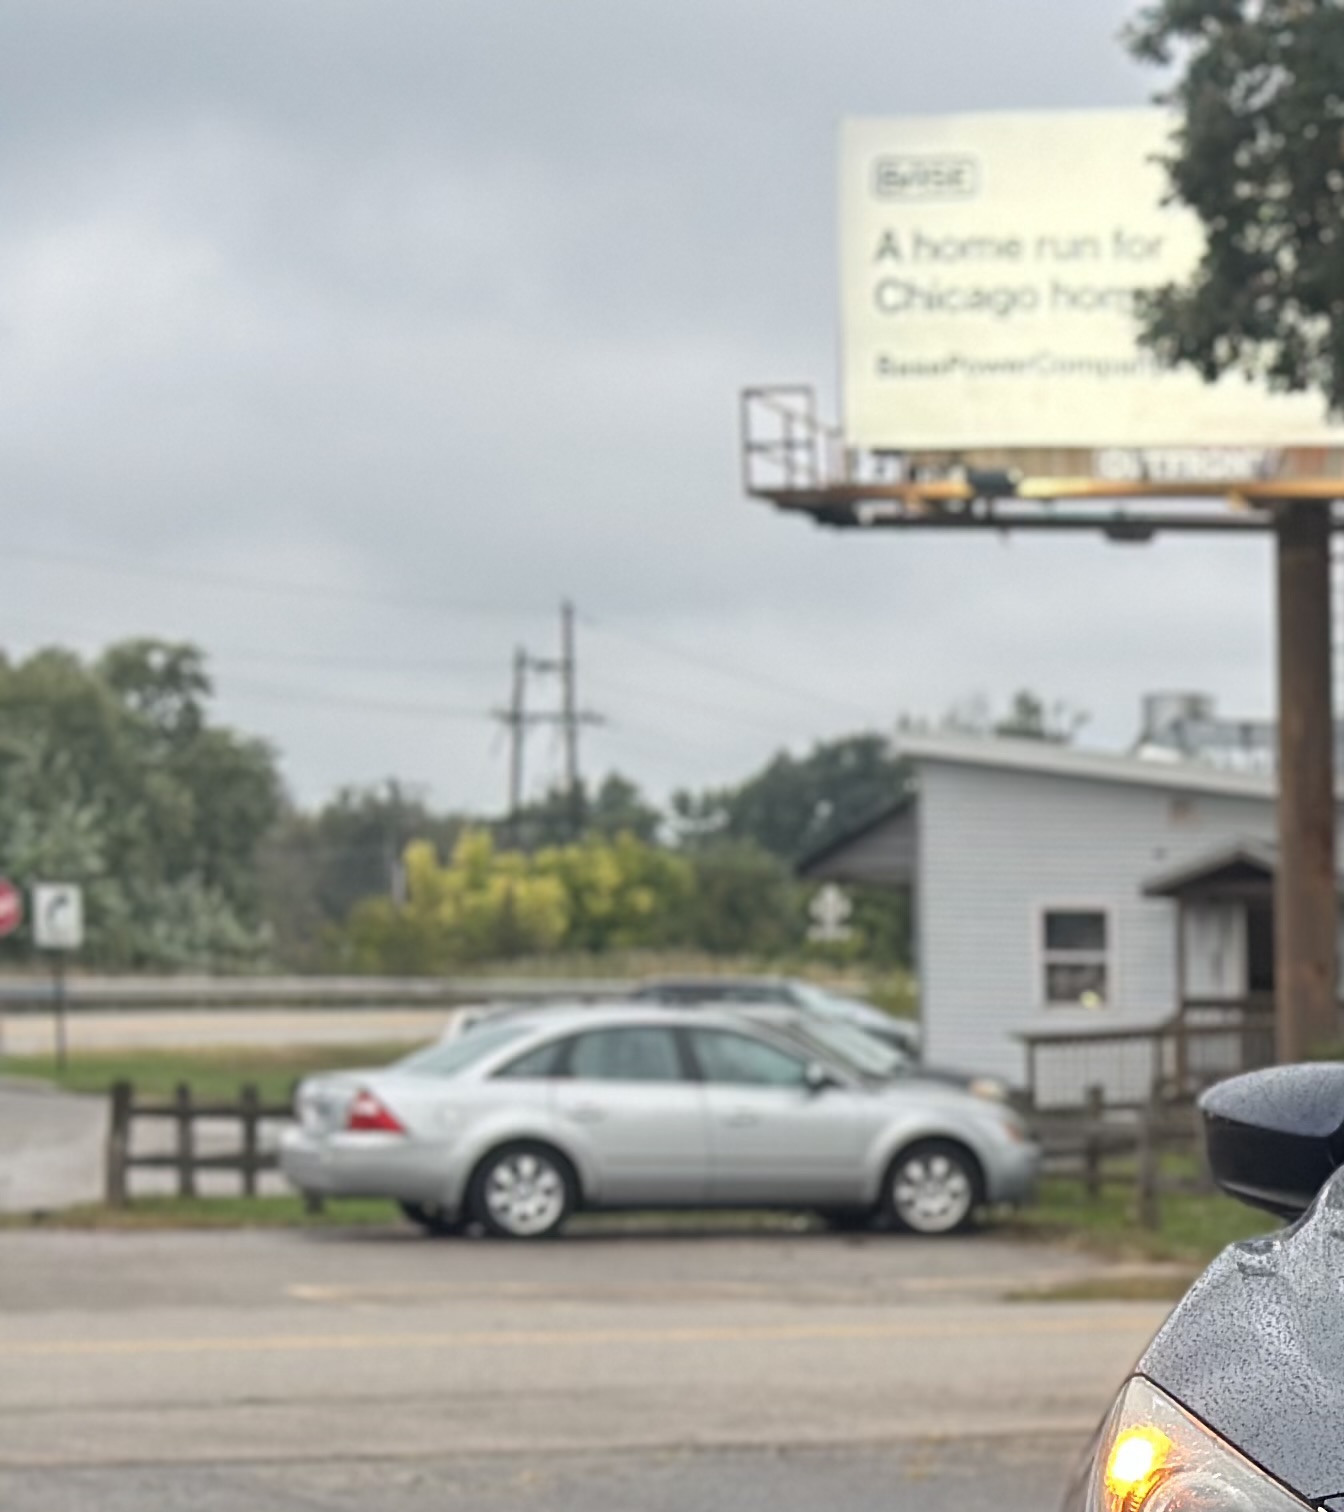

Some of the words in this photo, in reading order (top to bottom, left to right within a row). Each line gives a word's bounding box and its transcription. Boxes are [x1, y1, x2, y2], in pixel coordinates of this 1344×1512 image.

[874, 229, 902, 261] A
[912, 228, 1023, 260] home
[1035, 235, 1101, 260] run
[1111, 227, 1163, 260] for
[874, 278, 1040, 316] Chicago
[1050, 279, 1140, 310] hom
